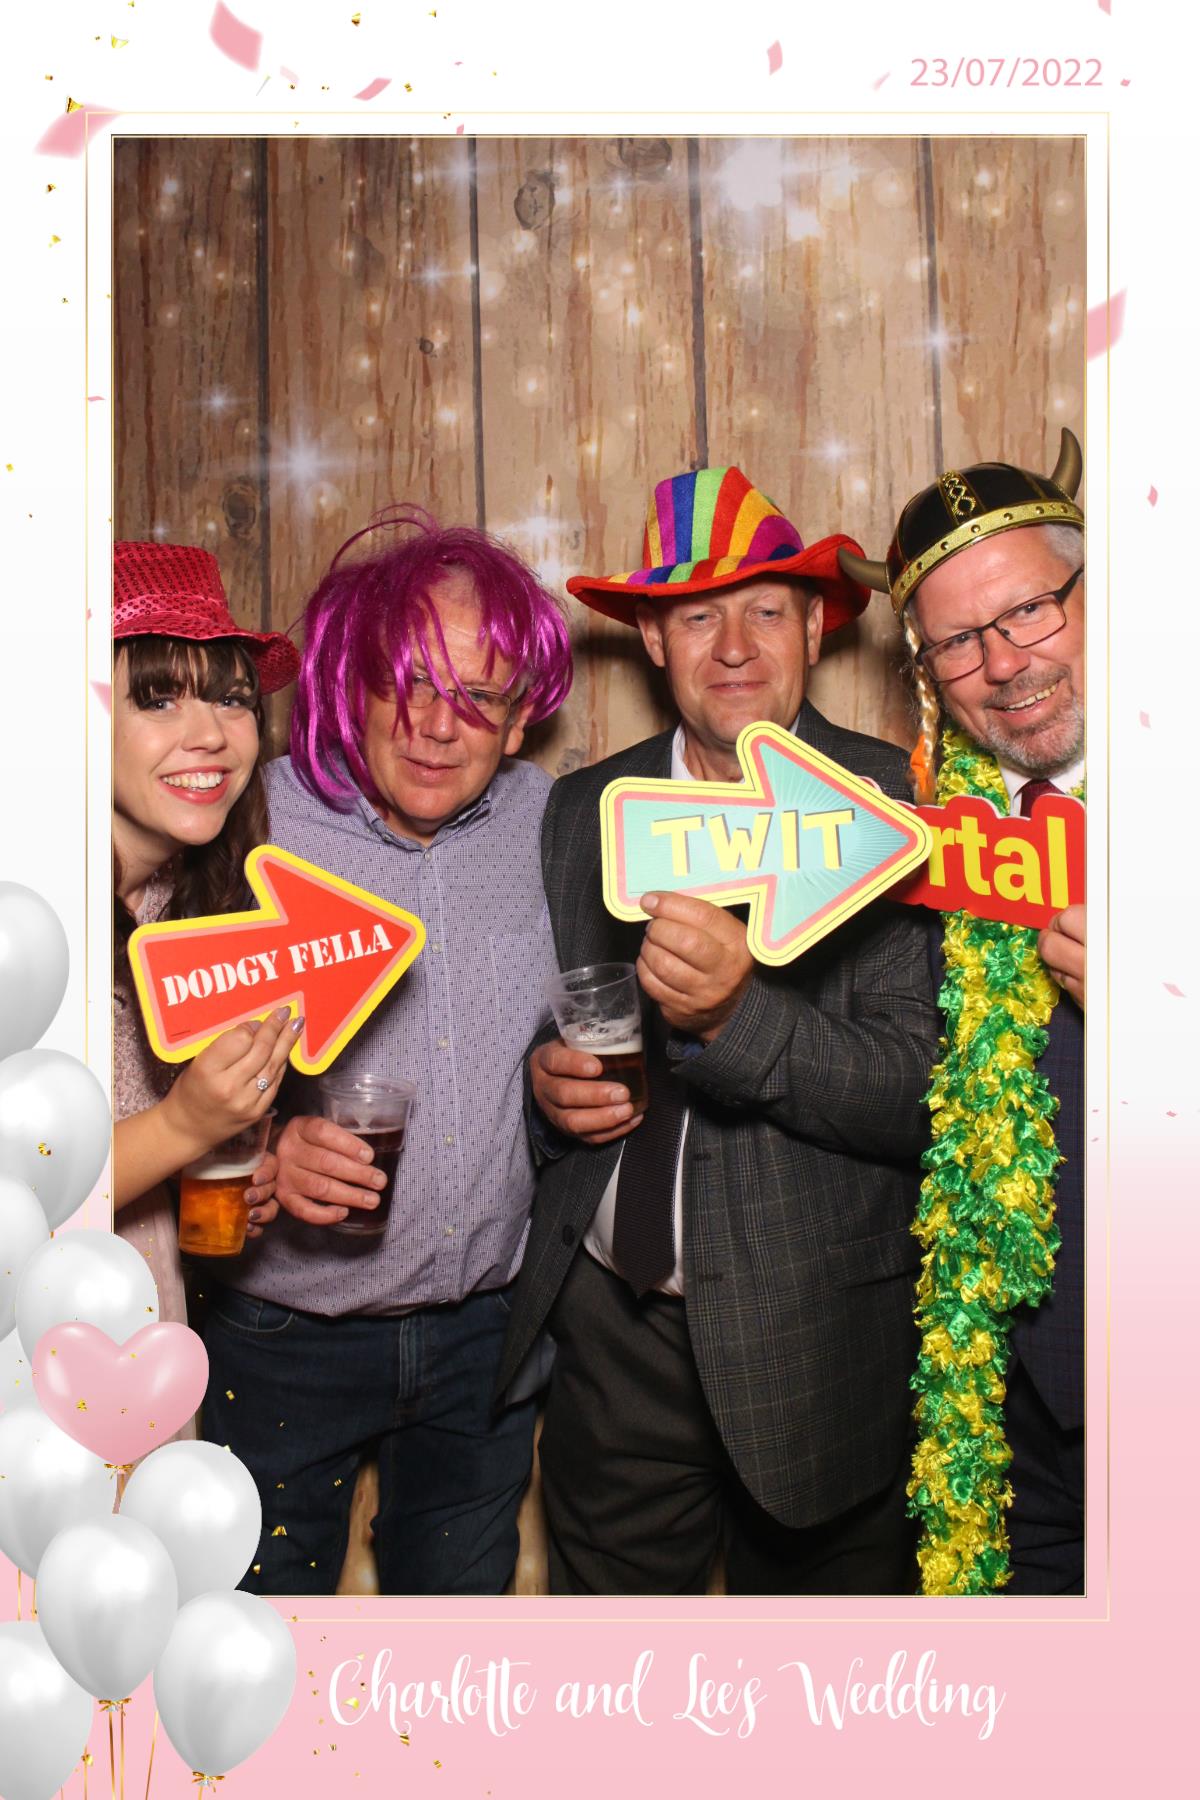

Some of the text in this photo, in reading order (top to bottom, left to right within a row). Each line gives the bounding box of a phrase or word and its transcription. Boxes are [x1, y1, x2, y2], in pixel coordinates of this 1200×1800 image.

[651, 808, 856, 877] TWIT
[161, 924, 393, 1007] DODGY FELLA
